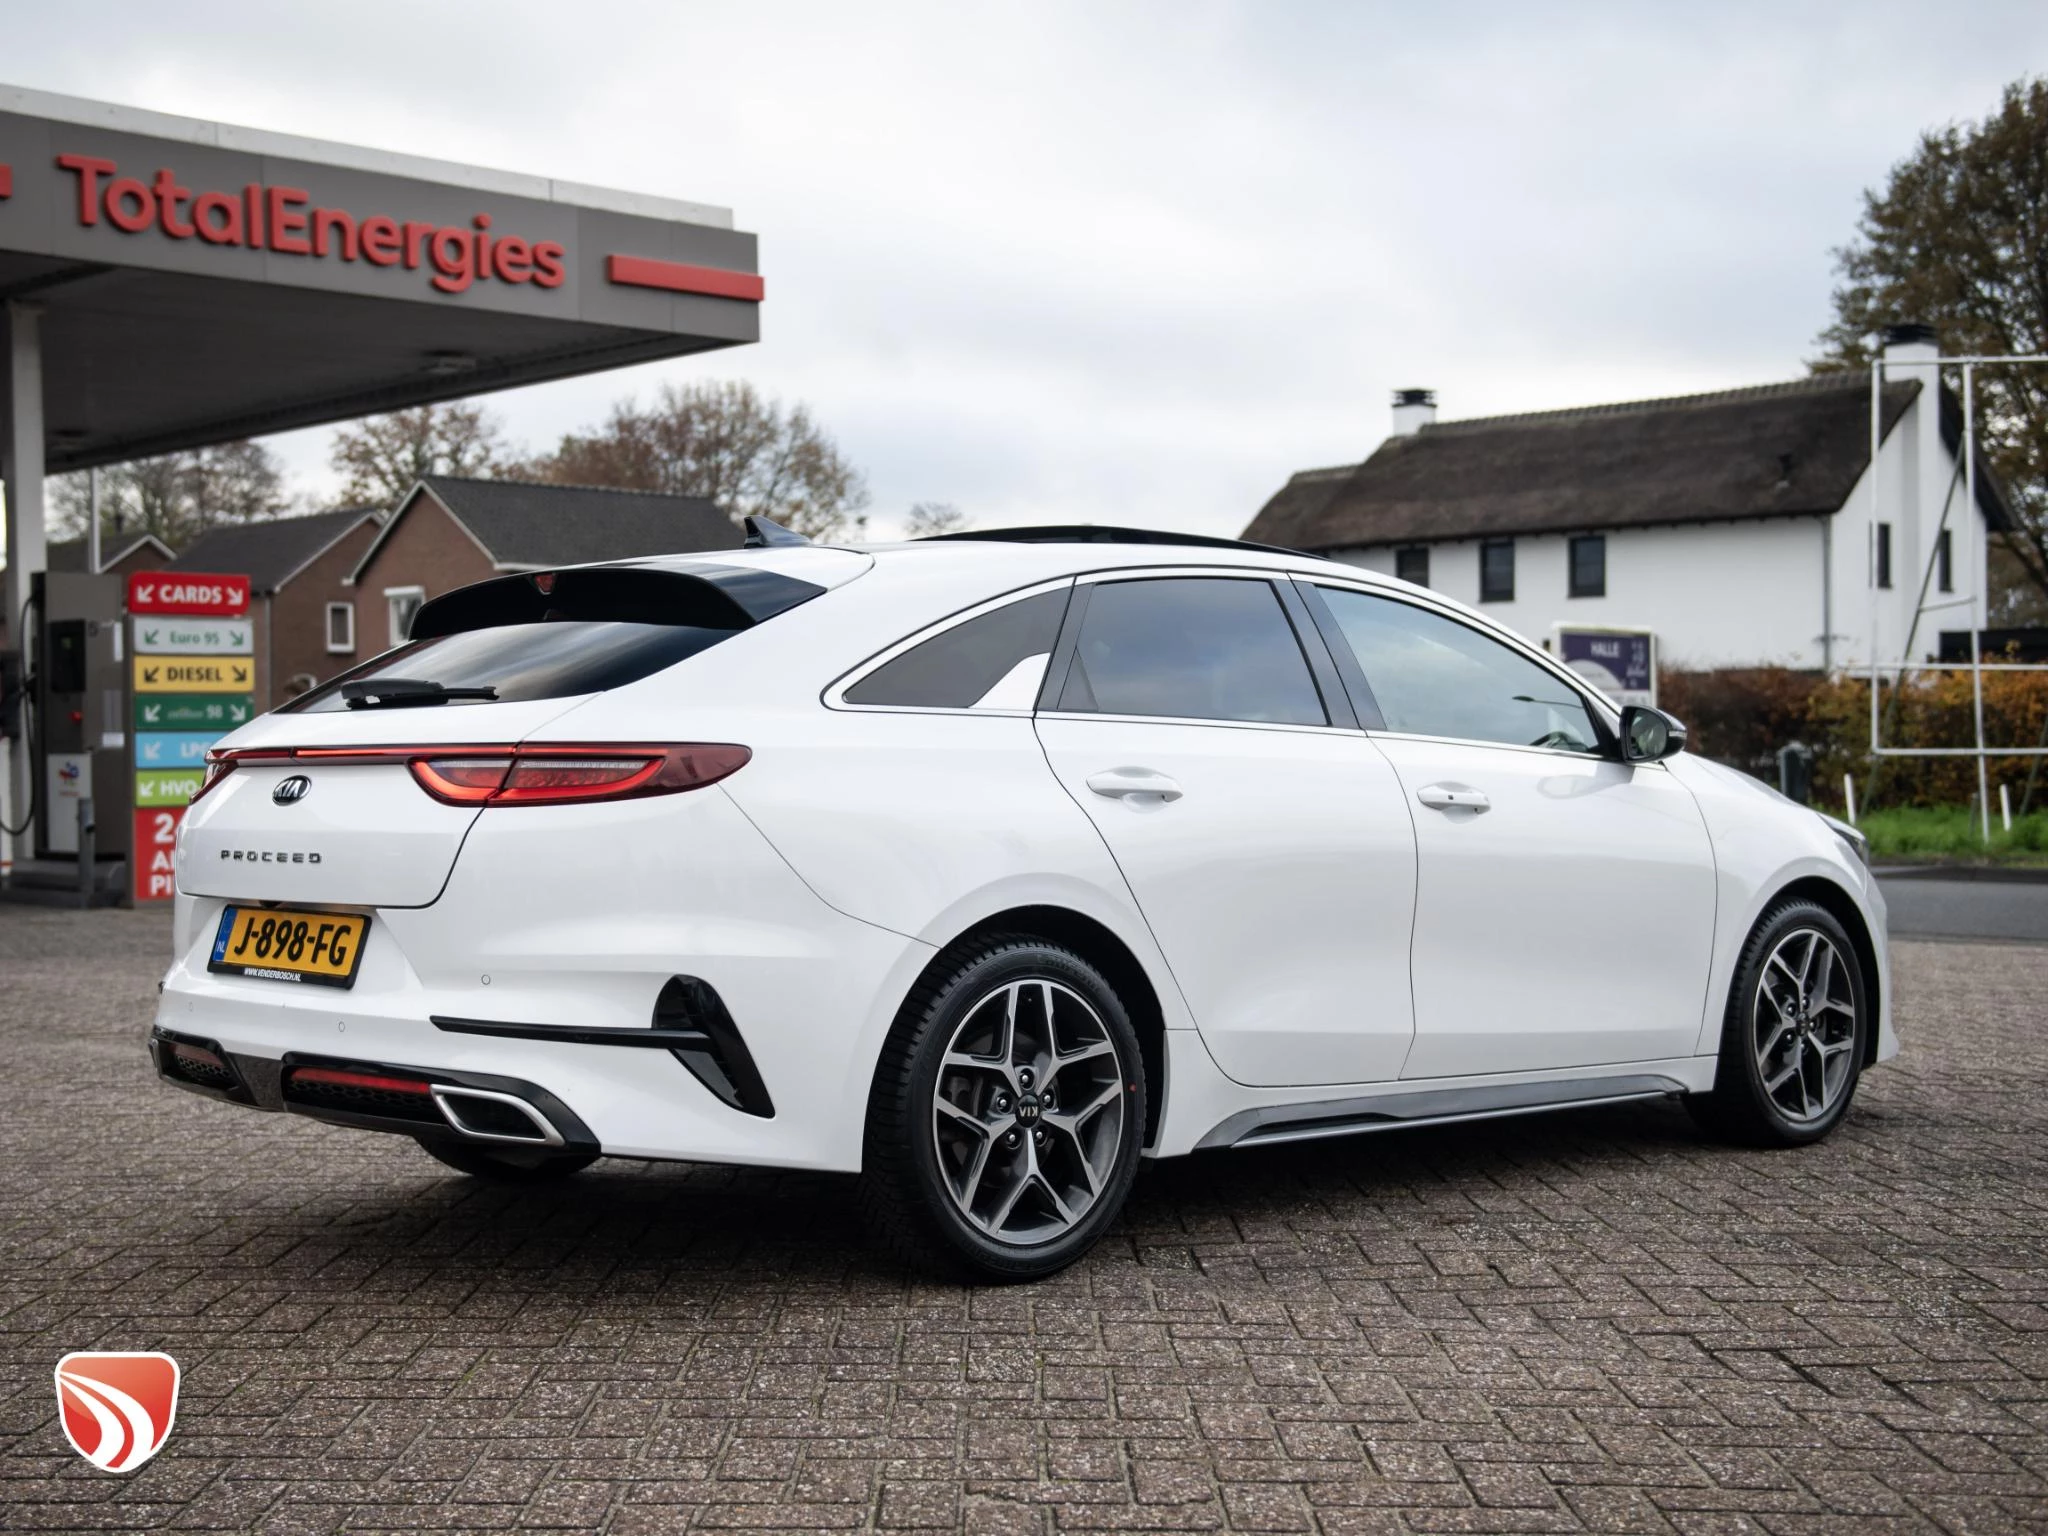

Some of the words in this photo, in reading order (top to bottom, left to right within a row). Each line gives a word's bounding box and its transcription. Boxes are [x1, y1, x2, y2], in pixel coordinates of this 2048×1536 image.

[56, 153, 566, 294] TotalEnergies
[159, 584, 223, 605] CARDS
[169, 631, 201, 645] Euro
[167, 666, 223, 682] DIESEL
[272, 777, 306, 801] KIA
[220, 849, 323, 863] PROCEED
[216, 940, 225, 953] NL
[233, 917, 352, 967] J-898-FG
[1018, 1105, 1039, 1117] KIA
